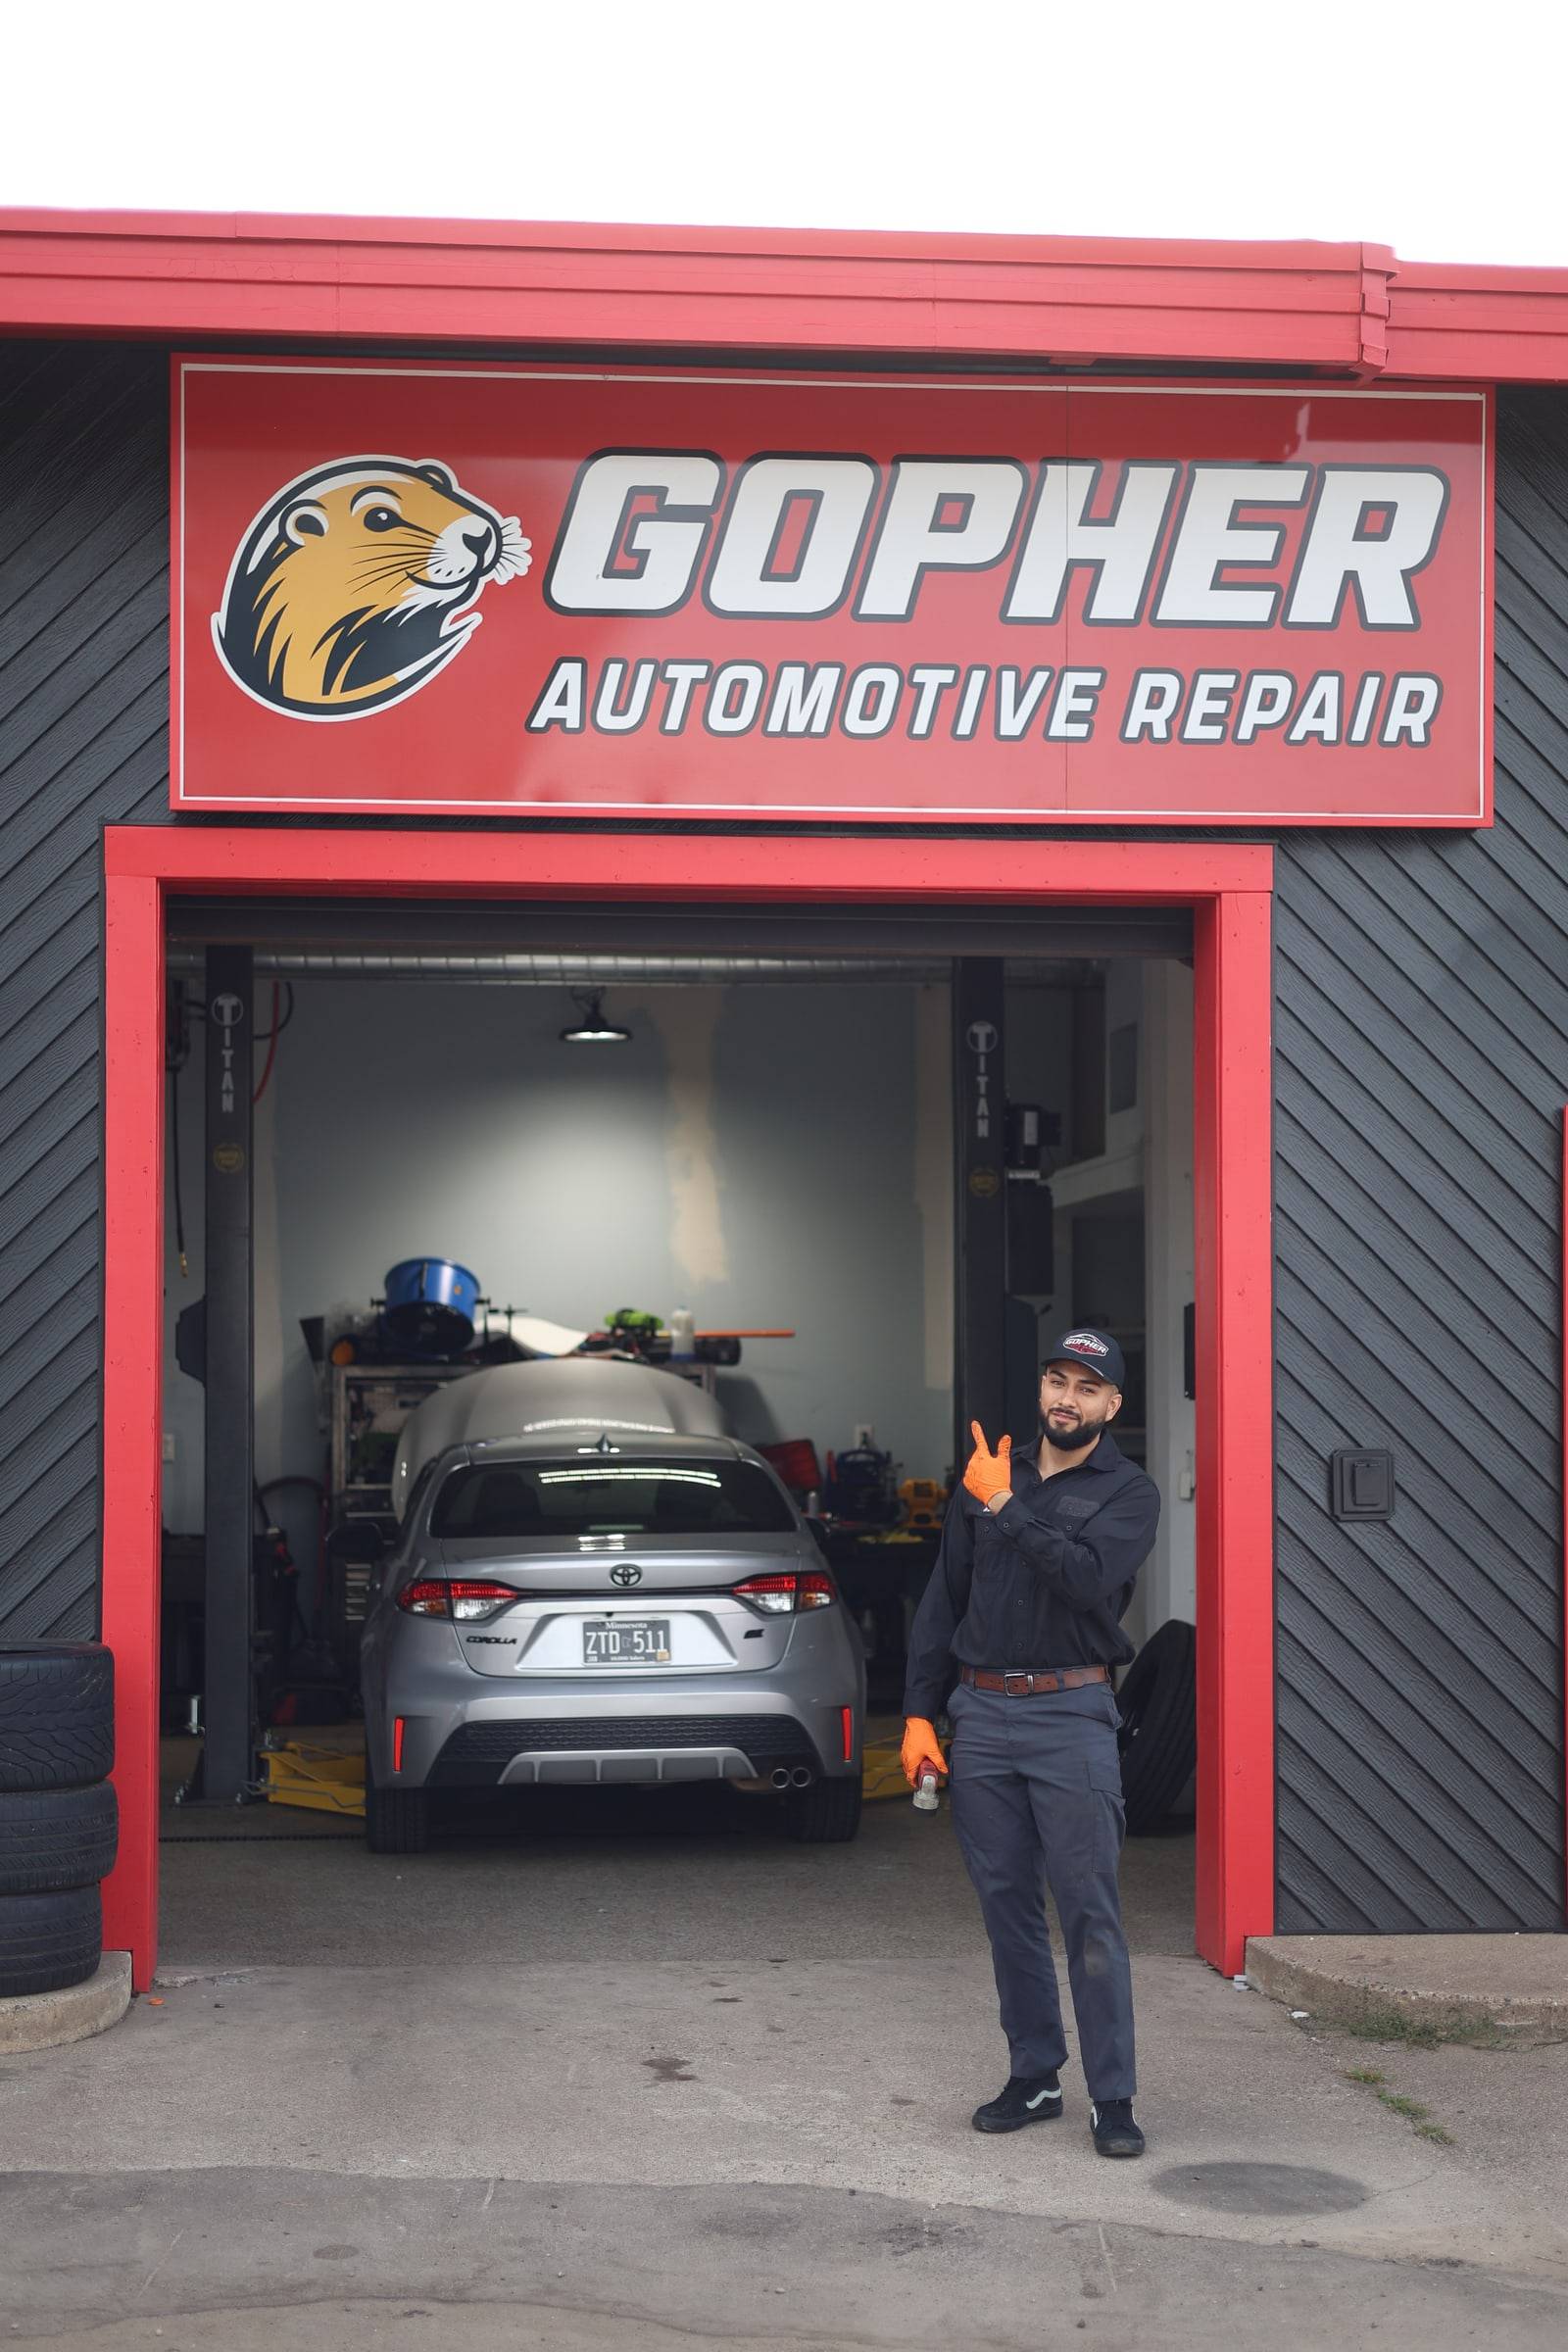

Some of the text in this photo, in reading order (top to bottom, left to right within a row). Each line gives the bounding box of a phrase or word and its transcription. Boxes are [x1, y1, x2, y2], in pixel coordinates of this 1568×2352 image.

[543, 447, 1450, 630] GOPHER
[526, 657, 1442, 747] AUTOMOTIVE REPAIR
[214, 993, 242, 1112] TITAN
[968, 1022, 996, 1137] TITAN
[1064, 1338, 1106, 1353] GOPHER
[466, 1636, 517, 1644] COROLLA
[586, 1630, 667, 1655] ZTD 511
[606, 1621, 648, 1630] Minnesota
